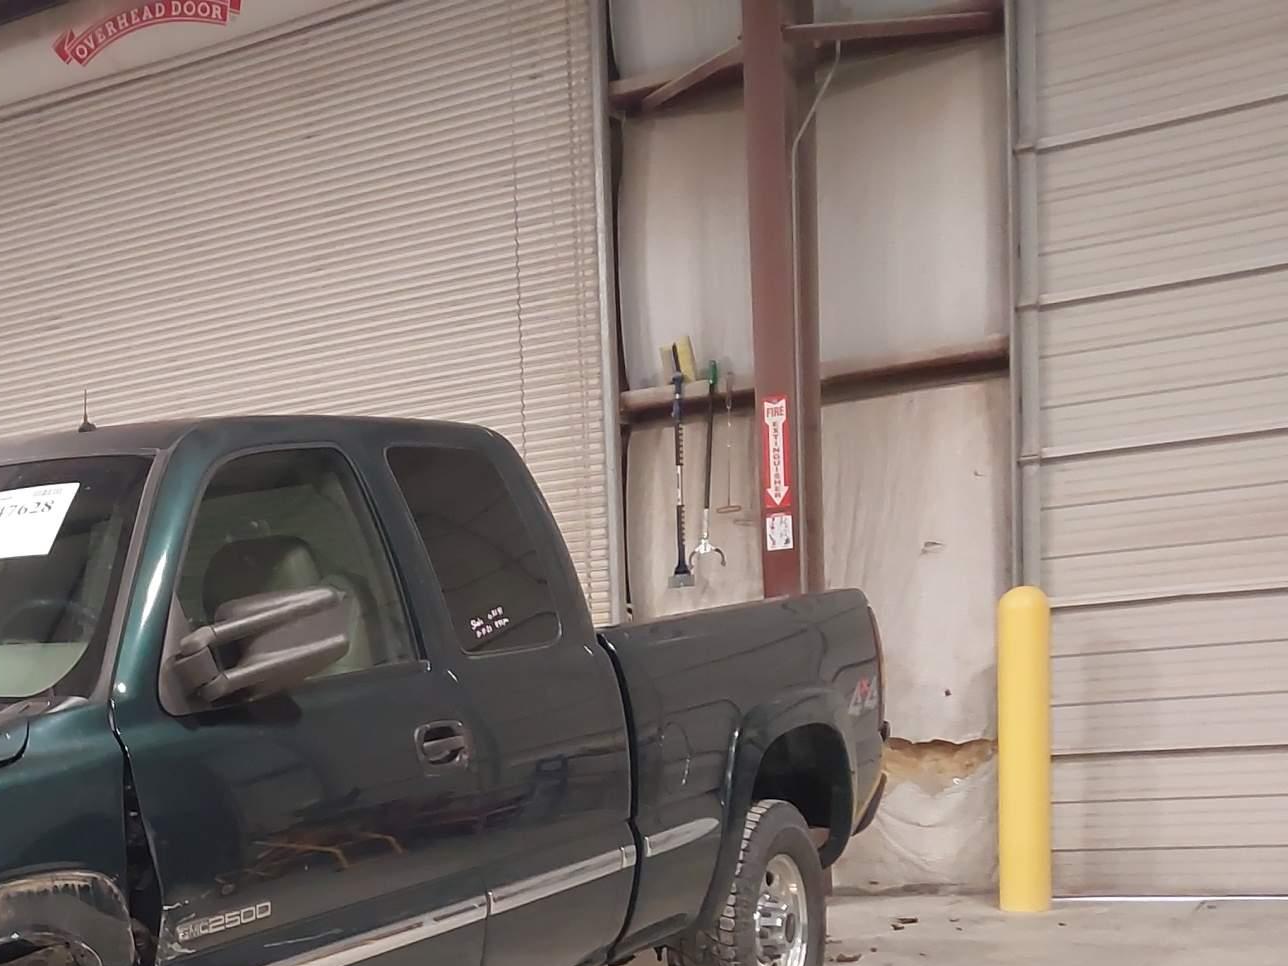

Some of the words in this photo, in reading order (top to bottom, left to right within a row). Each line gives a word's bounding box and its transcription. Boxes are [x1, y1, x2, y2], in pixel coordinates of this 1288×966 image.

[75, 3, 165, 59] OVERHEAD
[171, 1, 223, 20] DOOR
[766, 405, 784, 418] FIRE
[772, 421, 782, 499] EXTINGUISHER
